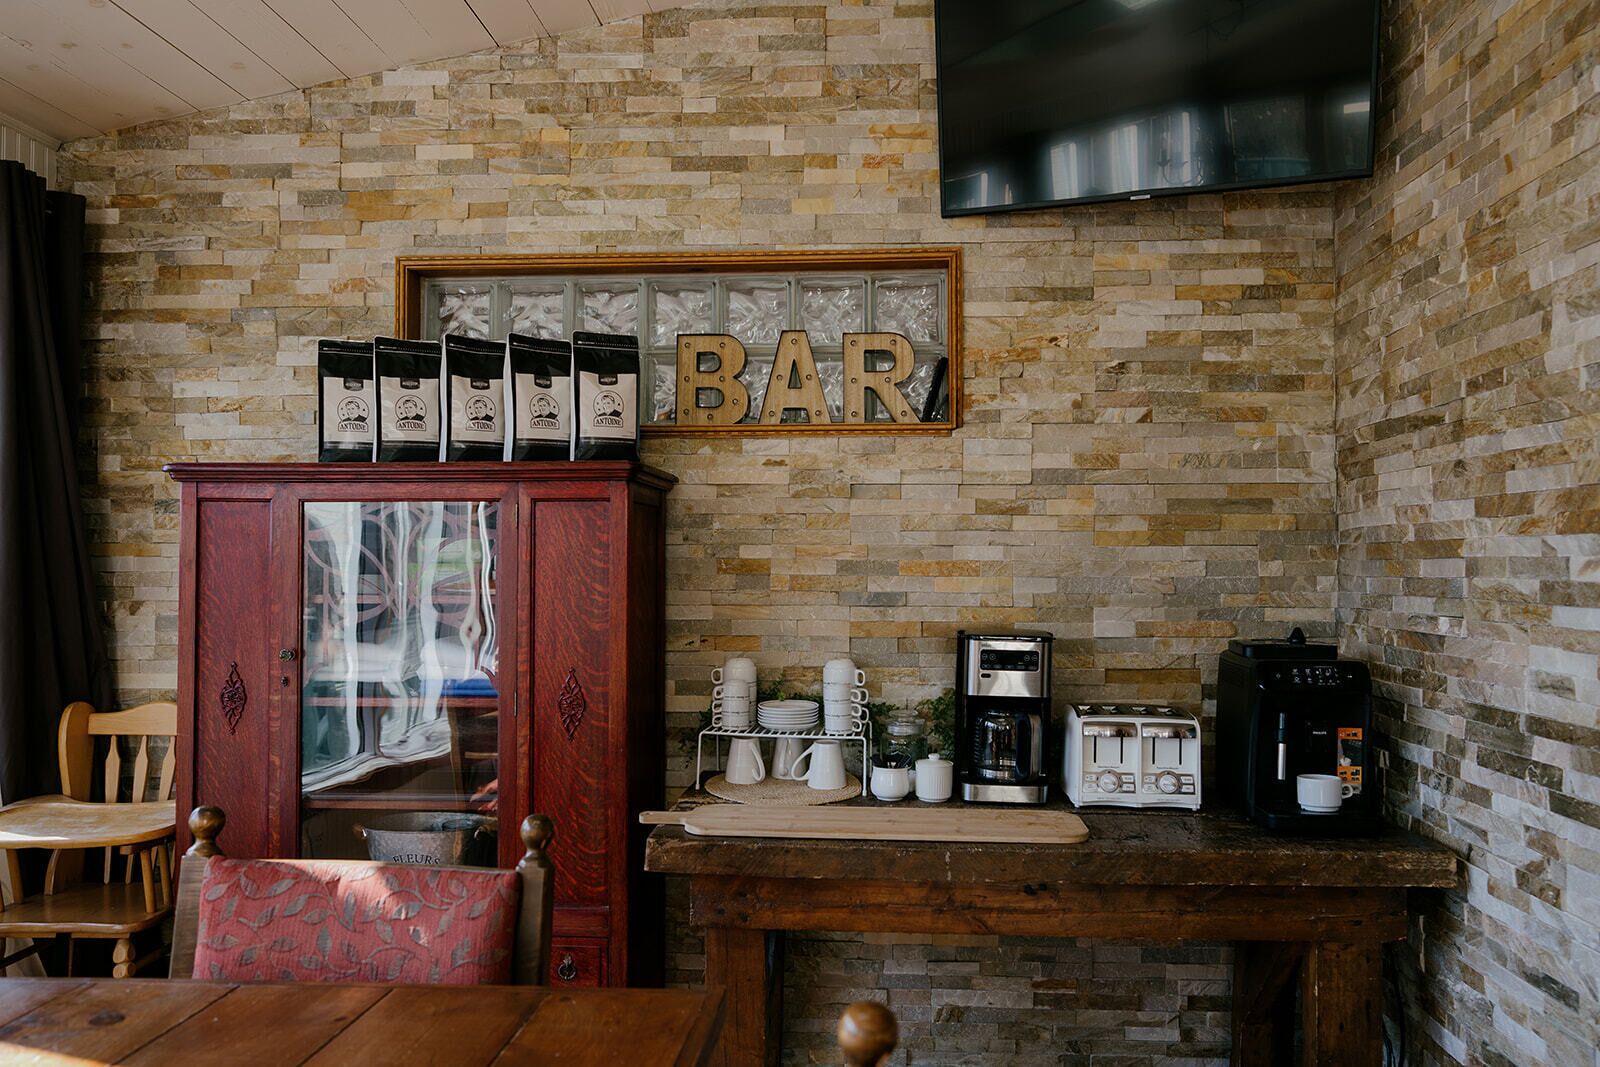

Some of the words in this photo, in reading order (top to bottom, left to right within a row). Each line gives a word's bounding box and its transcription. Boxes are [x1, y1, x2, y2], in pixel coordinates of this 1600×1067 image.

[675, 329, 922, 424] BAR
[340, 421, 367, 431] ANTOINE
[399, 420, 425, 431] ANTOINE
[467, 421, 494, 431] NTOINE
[532, 419, 558, 428] ANTOINE
[595, 416, 623, 426] ANTOINE
